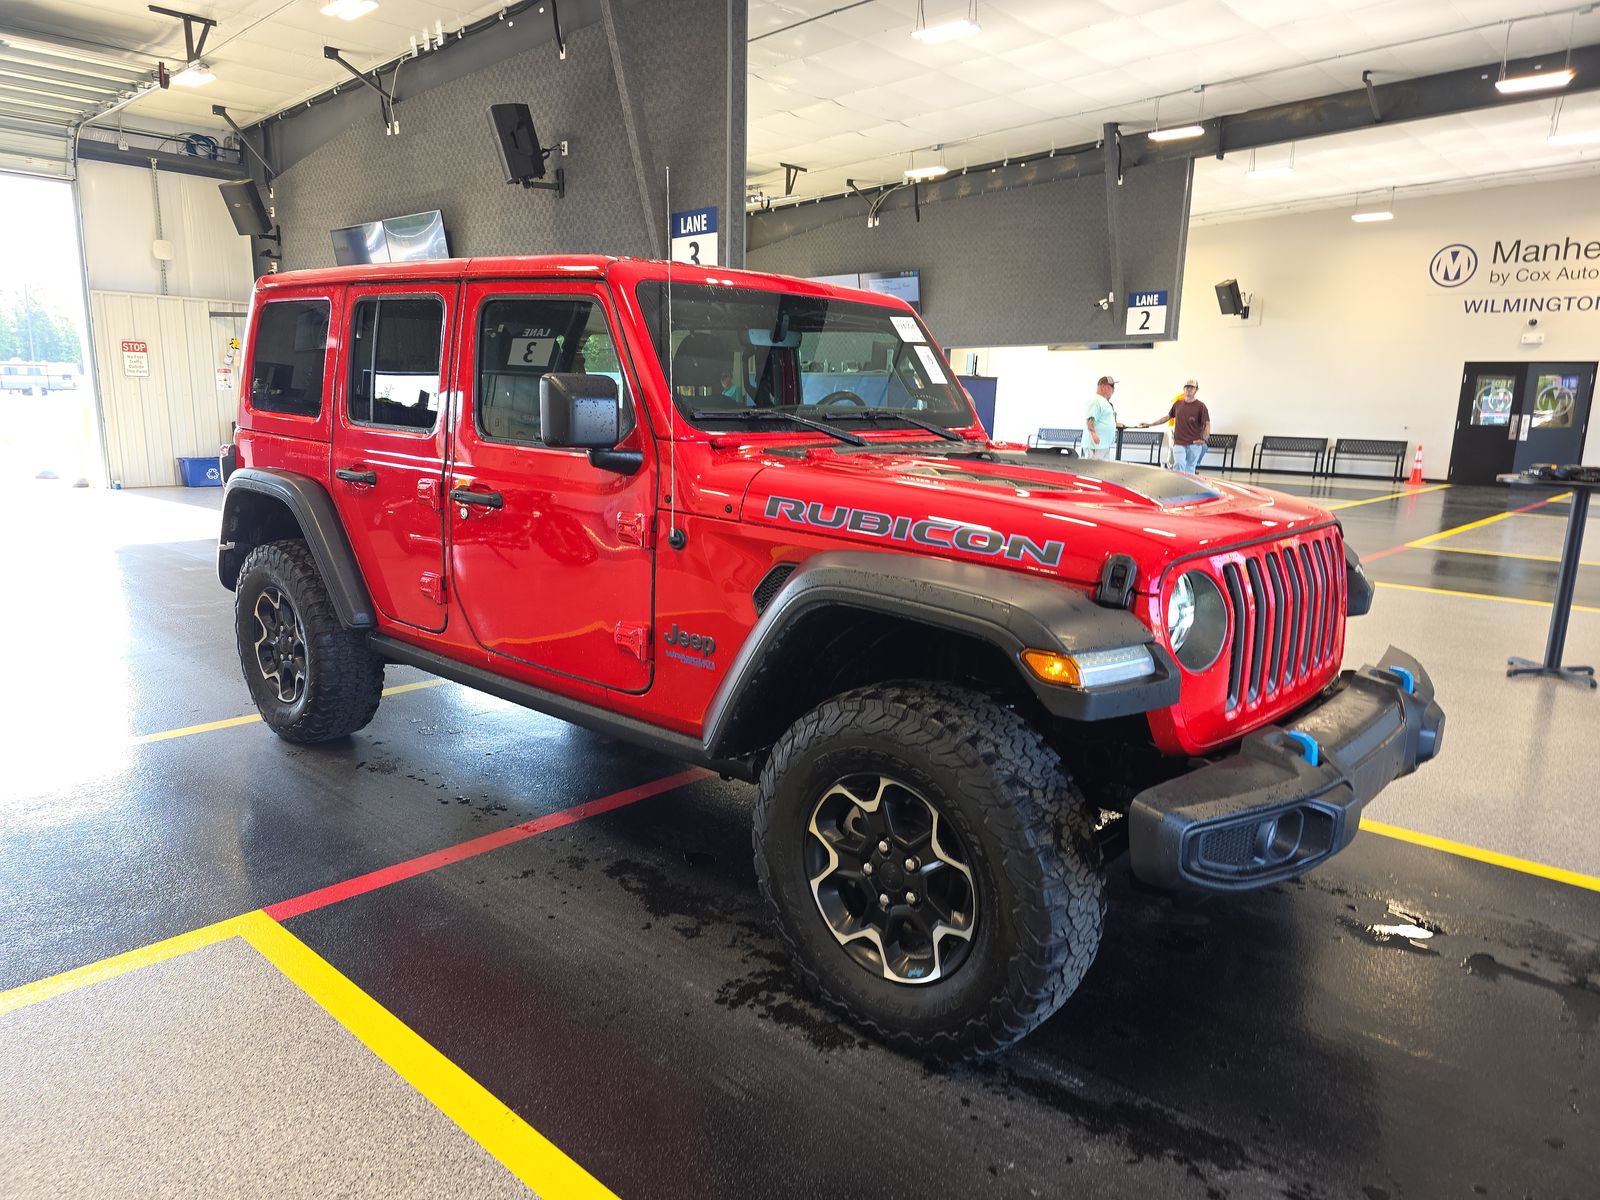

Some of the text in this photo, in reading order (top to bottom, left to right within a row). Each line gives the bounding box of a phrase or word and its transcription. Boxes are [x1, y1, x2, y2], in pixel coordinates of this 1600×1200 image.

[680, 213, 708, 234] LANE
[689, 241, 700, 265] 3
[1490, 266, 1600, 286] by Cox Auto
[1135, 294, 1159, 306] LANE
[1139, 310, 1151, 330] 2
[122, 342, 146, 352] STOP
[765, 495, 1065, 566] RUBICON
[664, 623, 716, 657] Jeep
